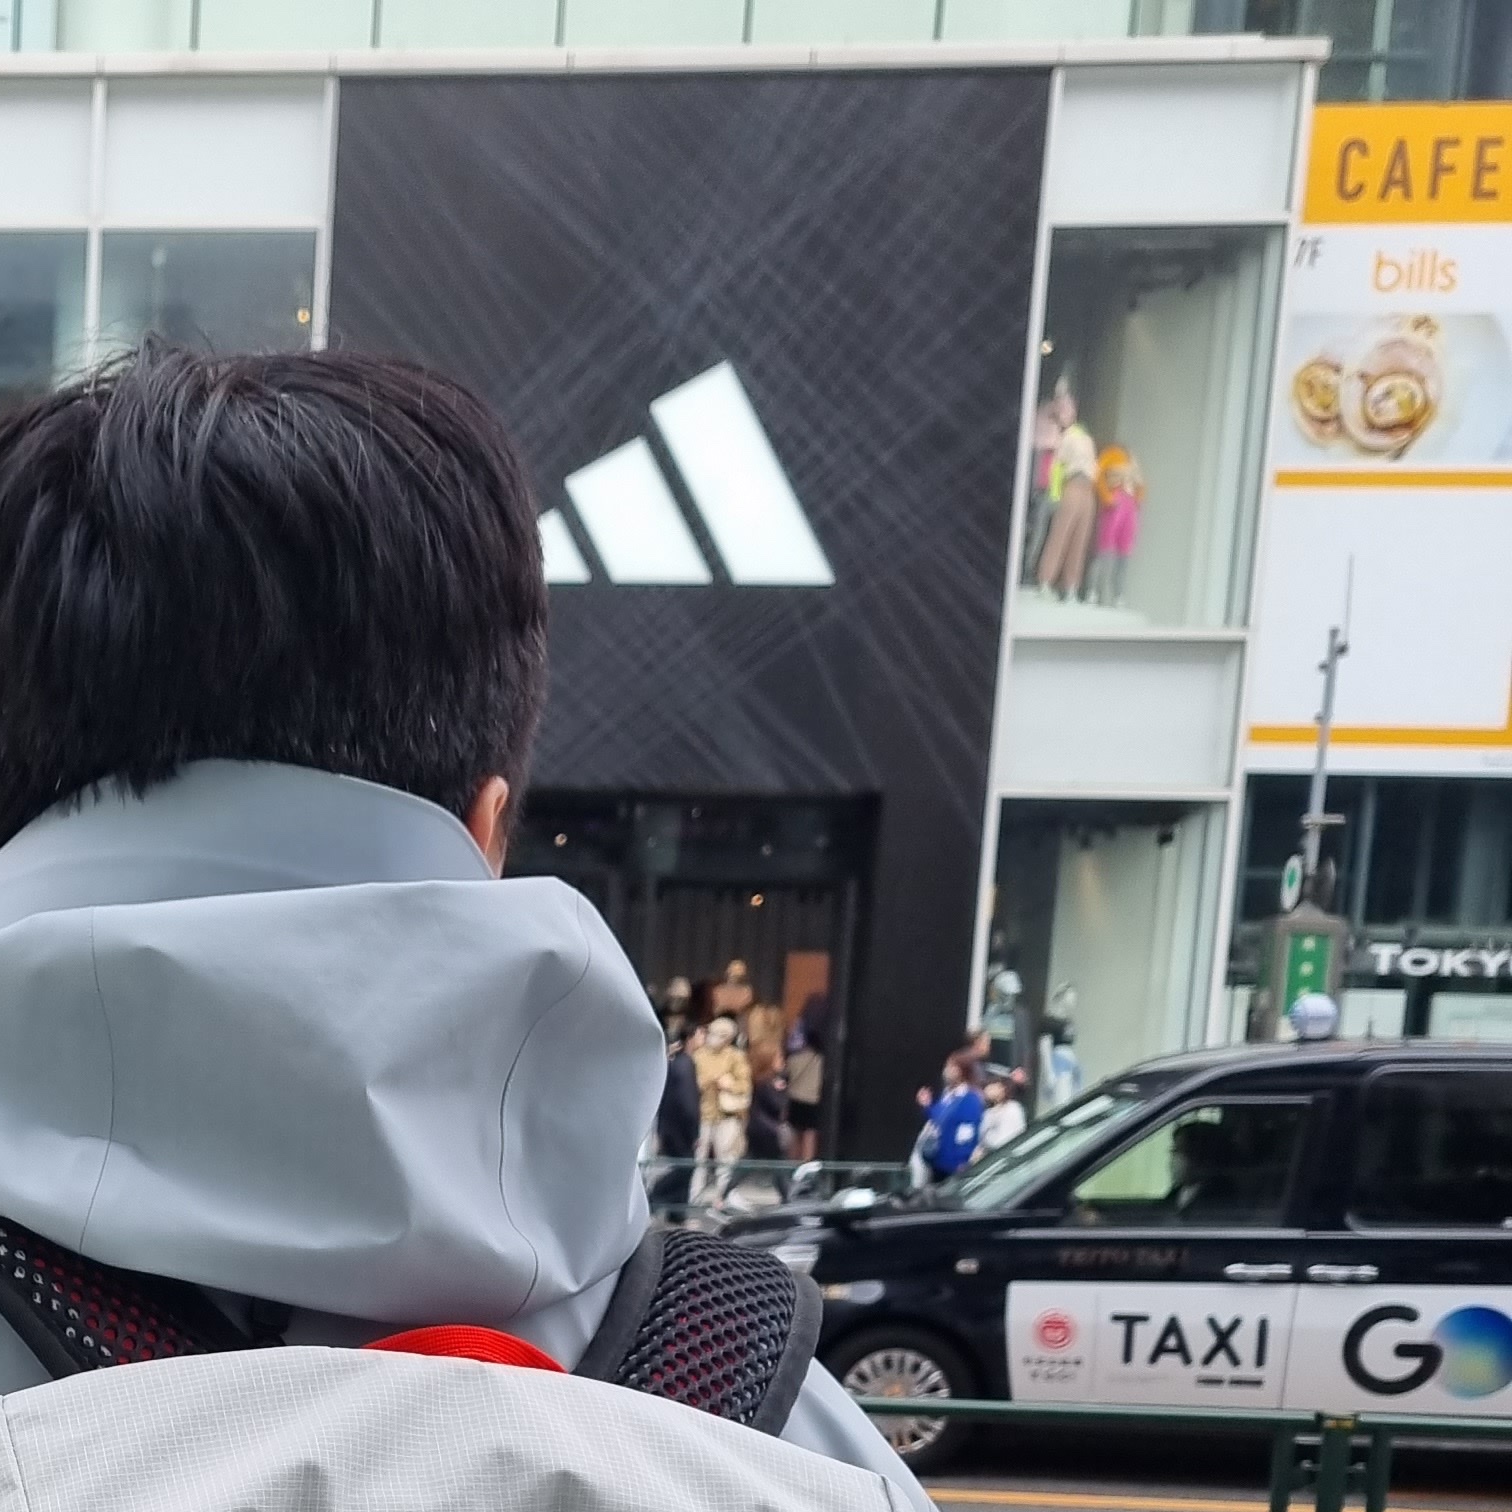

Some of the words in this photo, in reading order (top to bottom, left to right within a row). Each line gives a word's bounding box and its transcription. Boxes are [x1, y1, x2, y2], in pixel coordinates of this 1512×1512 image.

[1335, 138, 1504, 202] CAFE
[1374, 249, 1458, 292] bills
[1369, 941, 1512, 977] TOKY
[1111, 1314, 1268, 1368] TAXI
